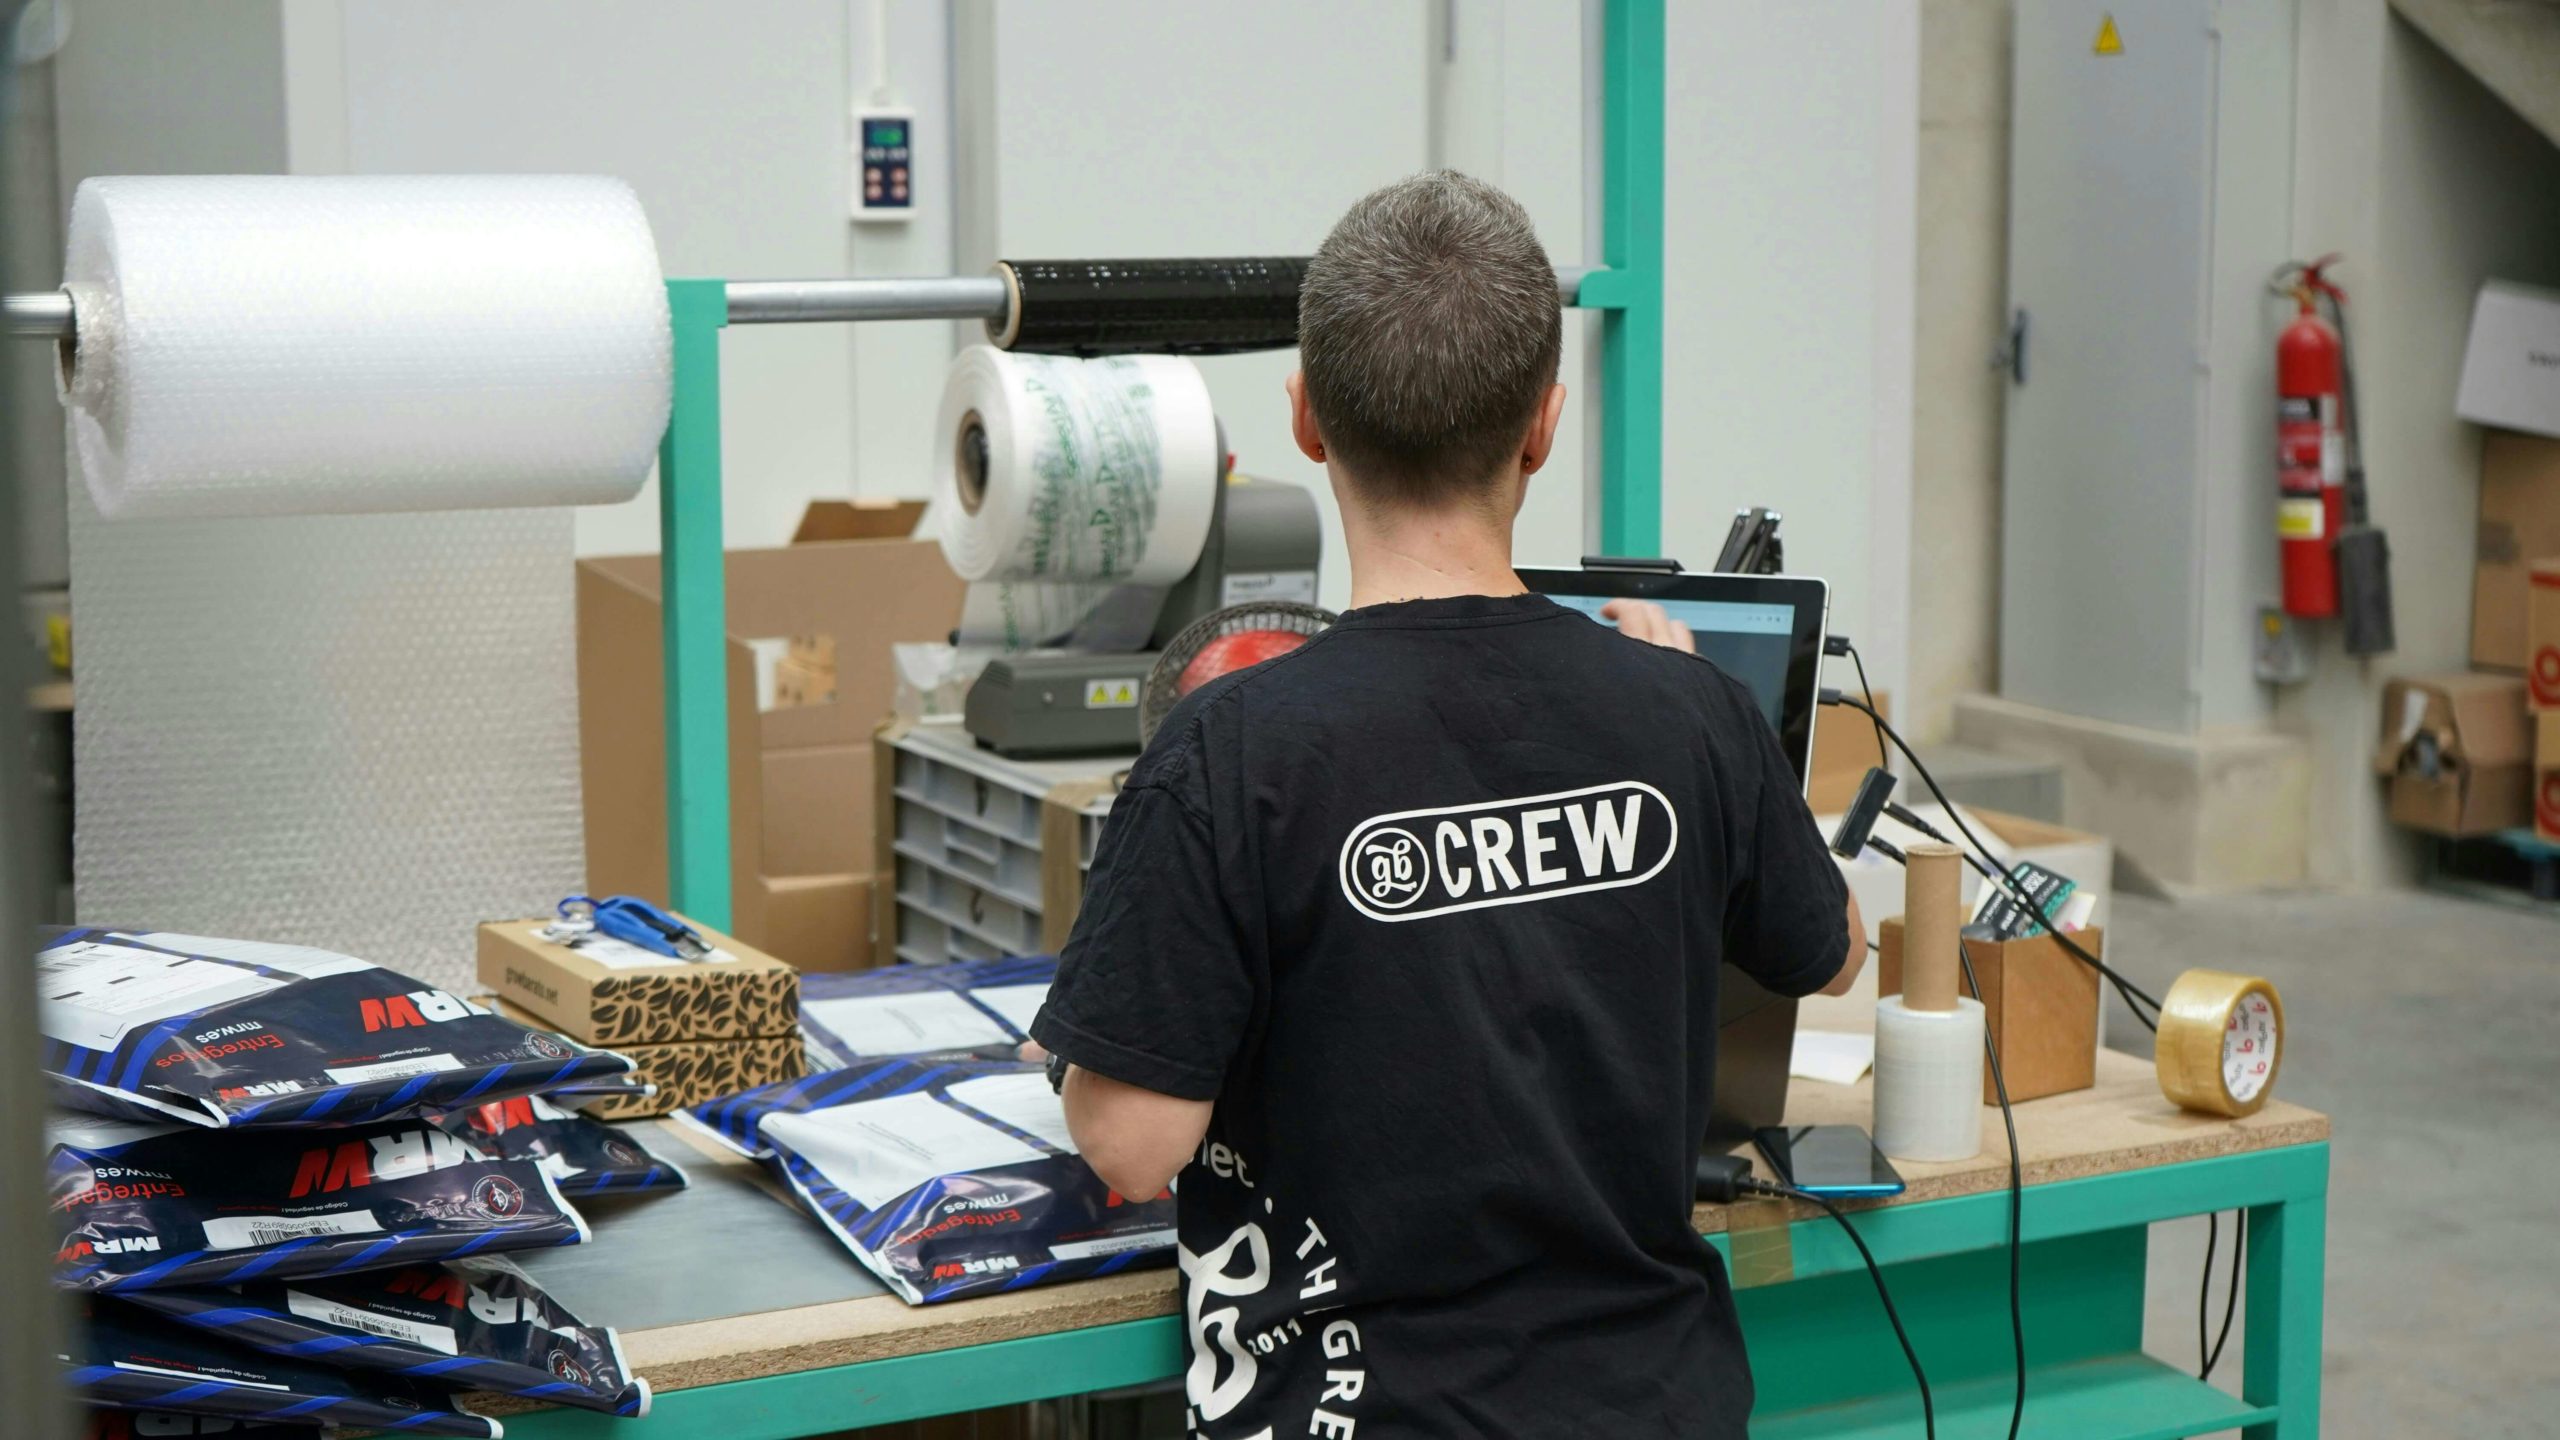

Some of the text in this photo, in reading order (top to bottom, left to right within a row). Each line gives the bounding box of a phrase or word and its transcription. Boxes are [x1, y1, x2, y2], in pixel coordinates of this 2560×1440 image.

[1366, 794, 1642, 898] gb CREW
[195, 1021, 263, 1044] mrw.es
[218, 1080, 304, 1101] MRW
[95, 1167, 172, 1180] mrw.es
[943, 1193, 1009, 1214] mrw.es
[933, 1256, 1020, 1280] MRW
[372, 1303, 403, 1314] seguridad
[413, 1311, 437, 1321] Código
[1247, 1318, 1303, 1356] 2011
